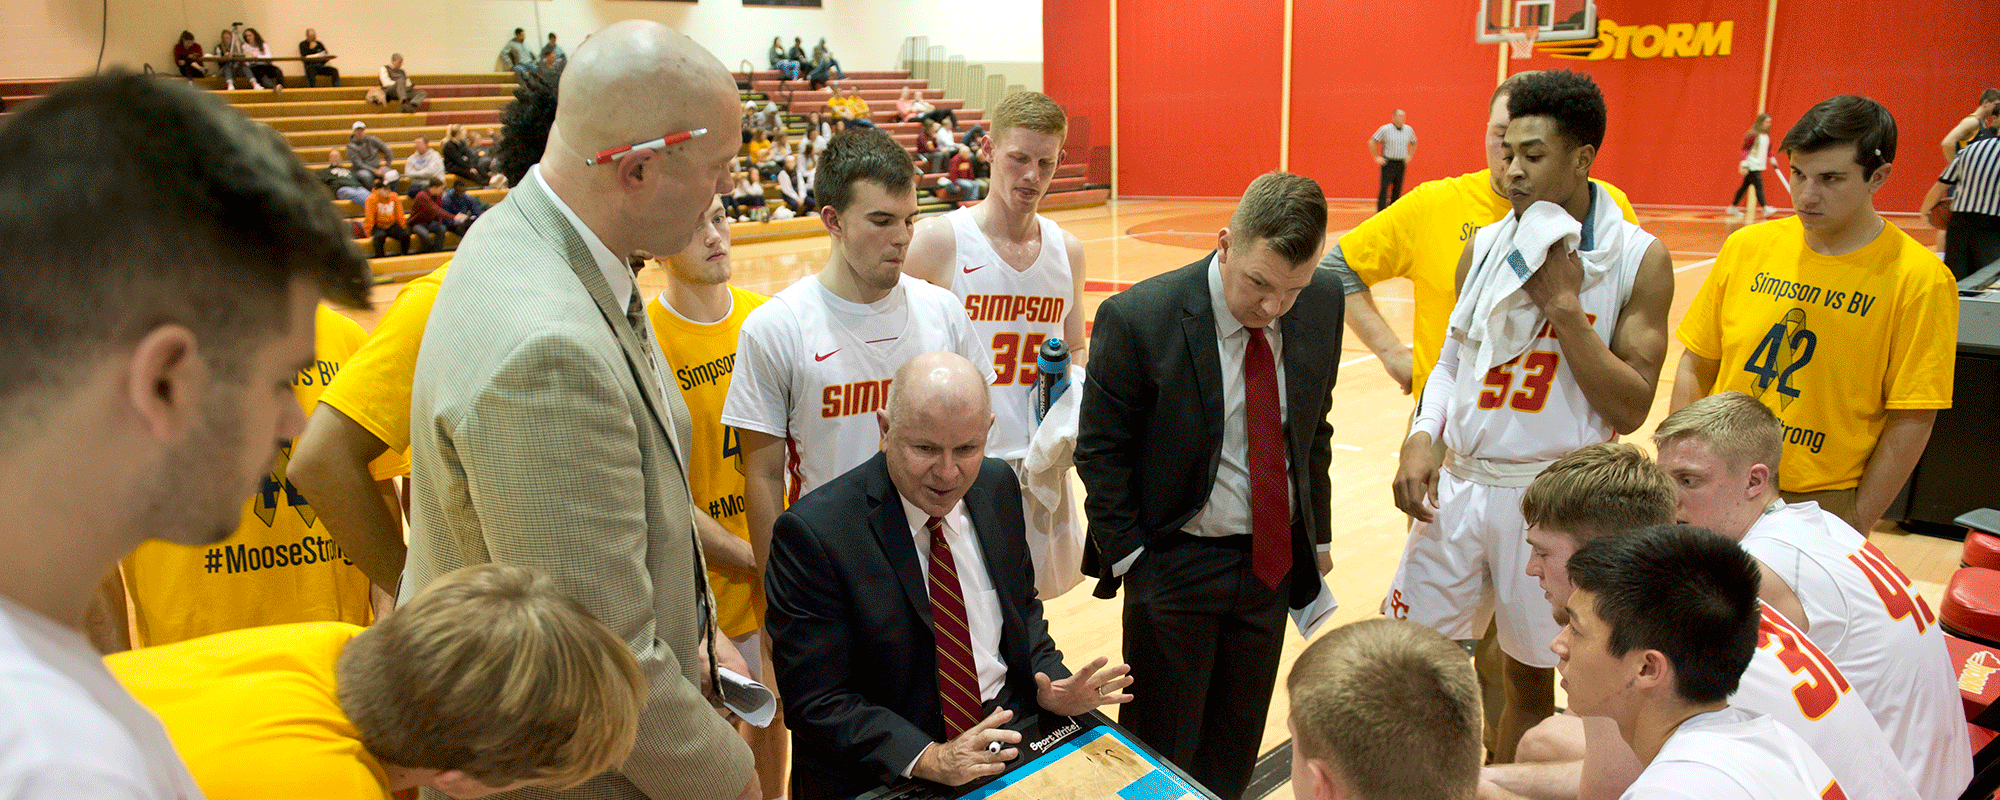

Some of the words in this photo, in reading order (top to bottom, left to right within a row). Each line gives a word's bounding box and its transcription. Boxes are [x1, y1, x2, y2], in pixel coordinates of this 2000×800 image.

[1588, 18, 1735, 61] STORM
[964, 294, 1065, 324] SIMPSON
[1750, 272, 1821, 302] Simpson
[1823, 289, 1846, 310] vs
[1846, 291, 1876, 317] BV
[989, 332, 1047, 387] 35
[1477, 350, 1560, 414] 53
[1743, 322, 1818, 399] 42
[1029, 733, 1055, 752] Sport
